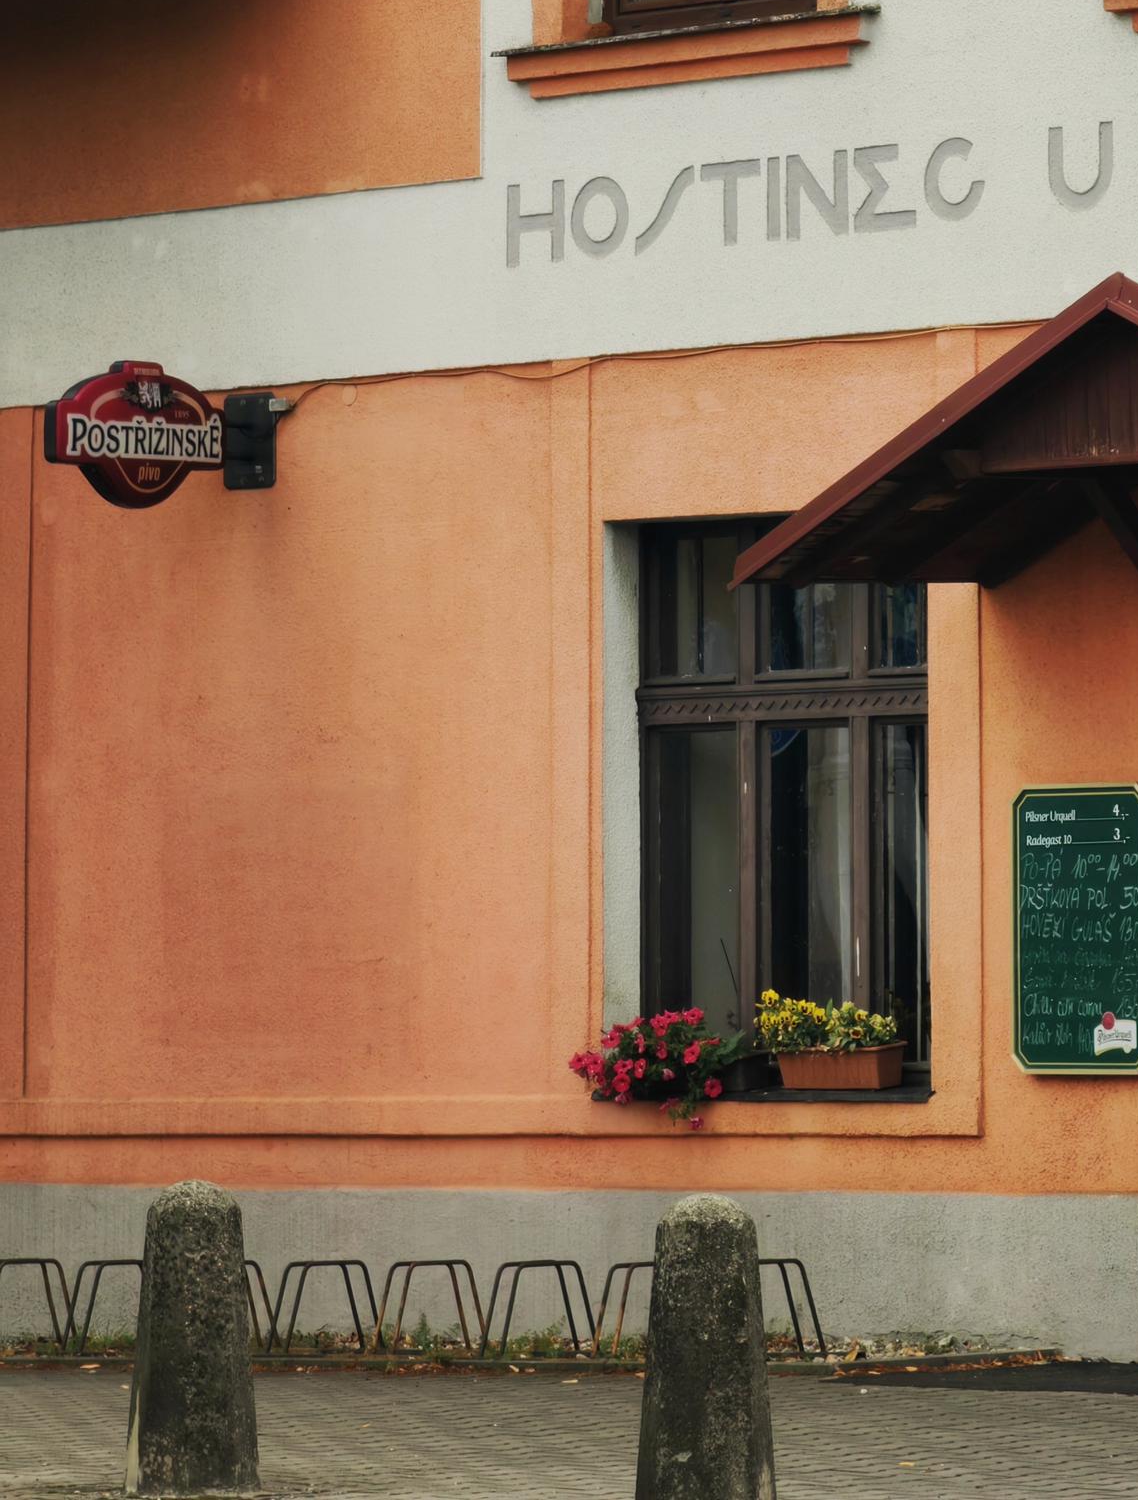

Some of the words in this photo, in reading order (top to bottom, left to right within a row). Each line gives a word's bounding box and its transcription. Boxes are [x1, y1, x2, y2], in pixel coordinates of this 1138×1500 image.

[1048, 122, 1113, 213] U
[138, 462, 161, 484] pivo
[1025, 811, 1050, 822] Pilsner
[1050, 809, 1076, 824] Urquell
[1026, 834, 1062, 848] Radegast
[1063, 834, 1073, 844] 10
